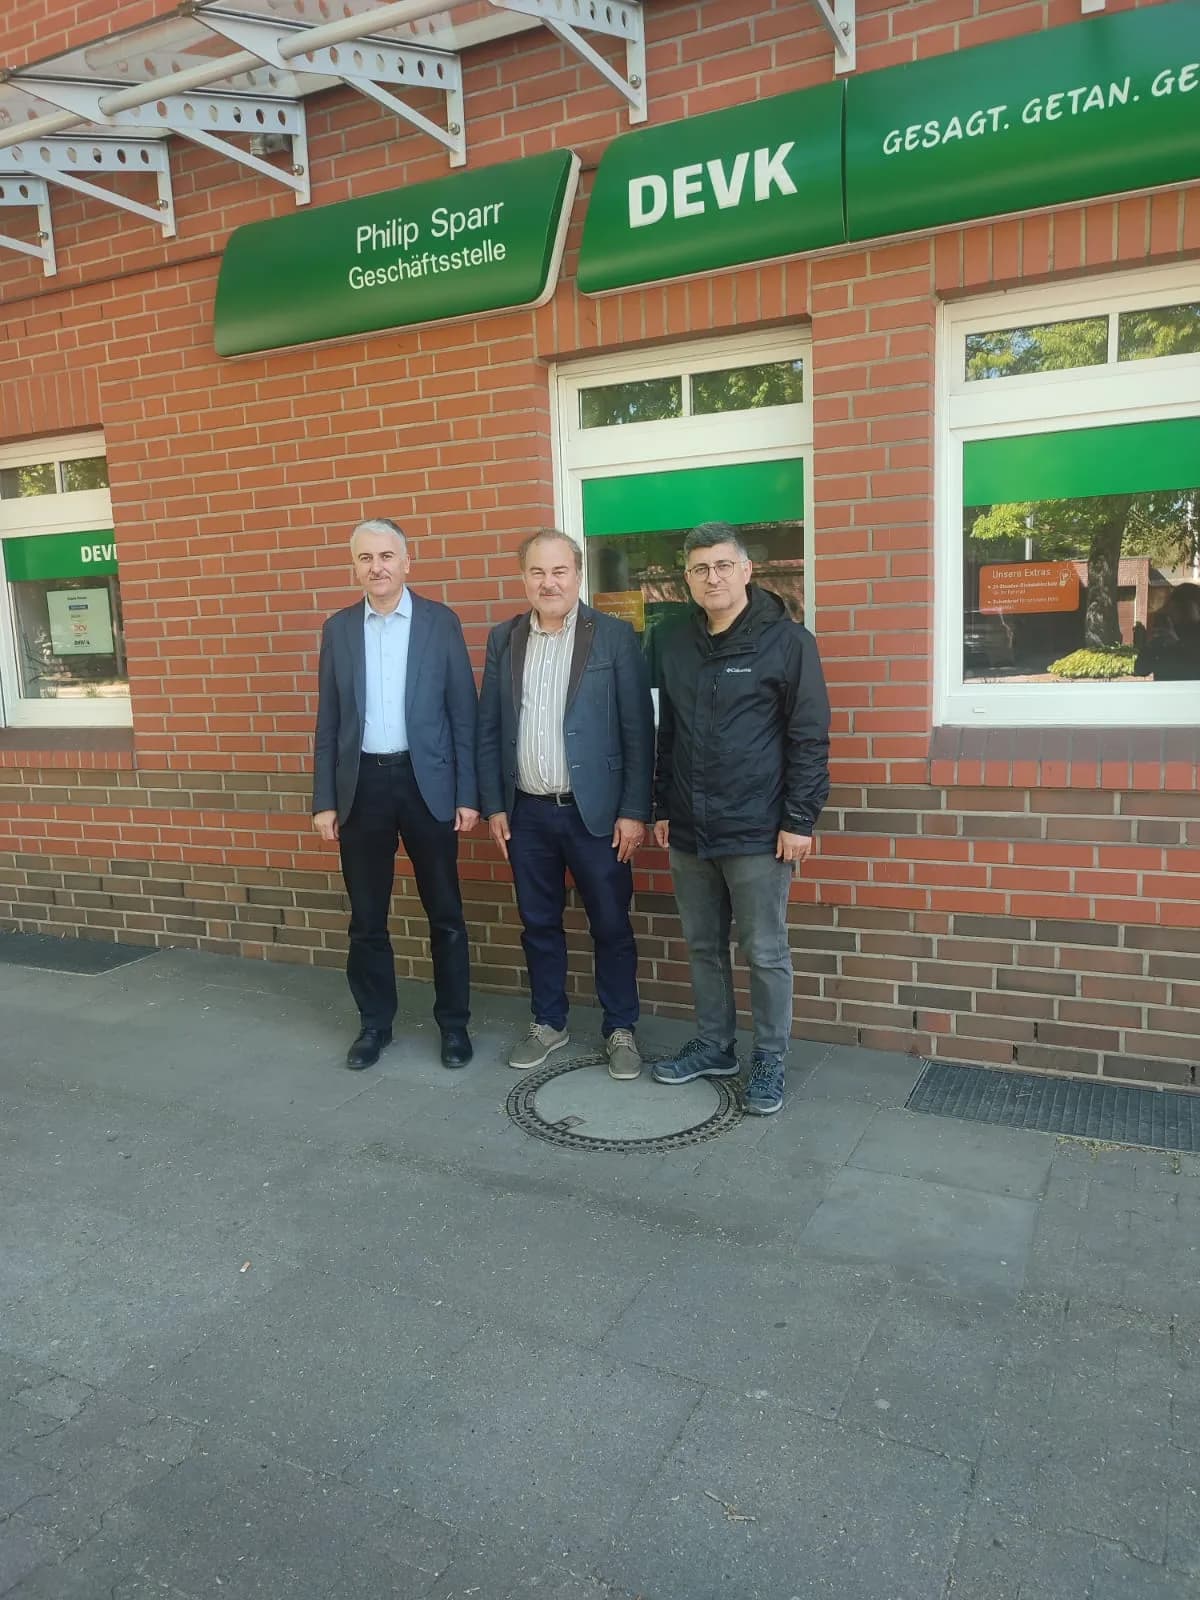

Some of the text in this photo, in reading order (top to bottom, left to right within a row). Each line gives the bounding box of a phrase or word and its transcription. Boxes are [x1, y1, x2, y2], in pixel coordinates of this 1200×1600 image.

[882, 105, 1010, 155] GESAGT.
[1021, 76, 1139, 124] GETAN.
[628, 141, 798, 229] DEVK
[356, 201, 505, 254] Philip Sparr
[348, 239, 507, 290] Geschäftsstelle
[1024, 567, 1052, 577] Extras
